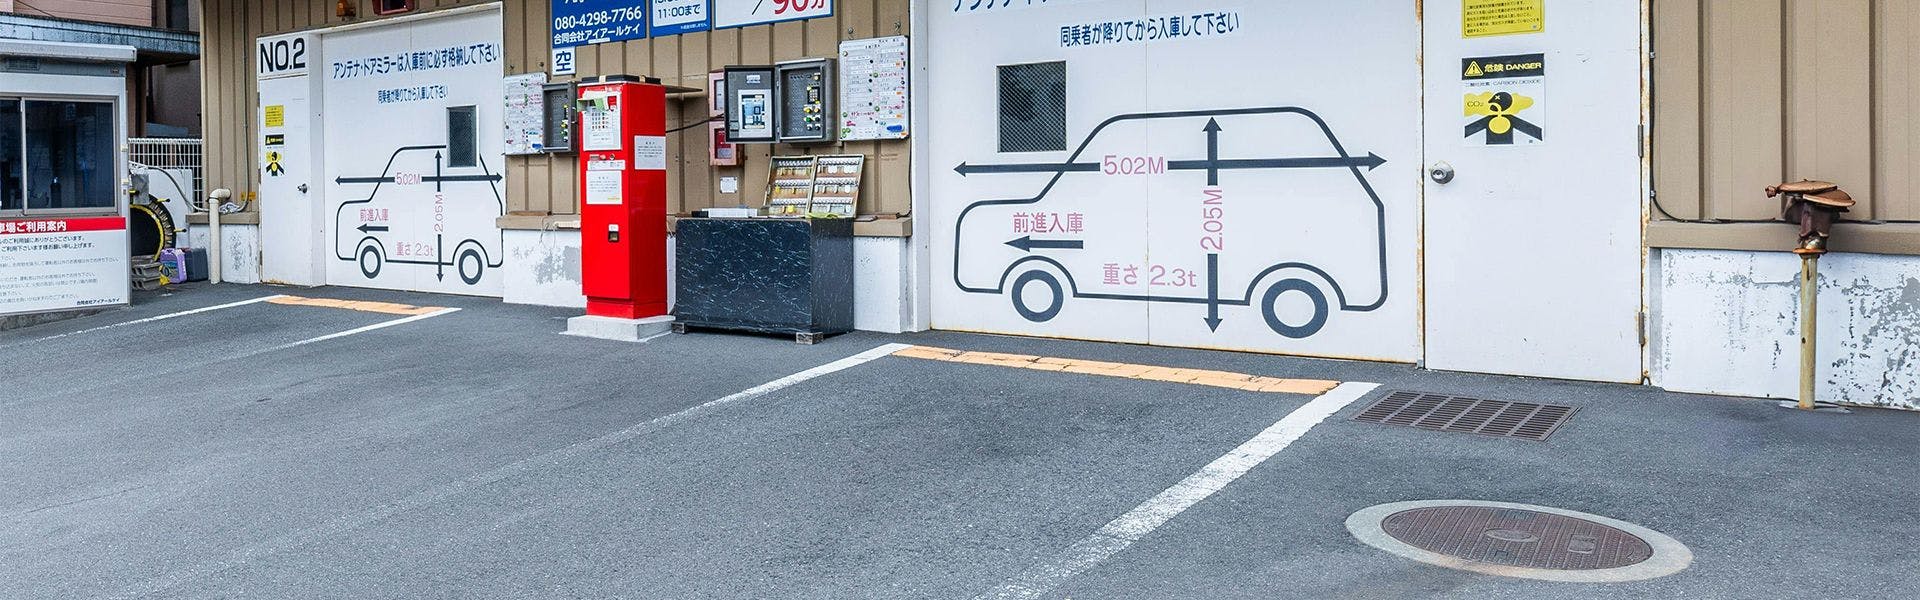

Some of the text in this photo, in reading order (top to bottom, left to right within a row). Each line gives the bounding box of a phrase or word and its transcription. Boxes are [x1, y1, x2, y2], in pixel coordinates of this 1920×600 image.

[555, 6, 642, 30] 080-4298-7766
[658, 4, 701, 19] 11:00まで
[554, 24, 641, 45] 合同会社アイアールケイ
[1060, 12, 1238, 47] 同乗者が降りてから入庫して下さい
[261, 38, 306, 73] NO.2
[556, 51, 572, 72] 空
[1505, 62, 1542, 71] DANGER
[1104, 155, 1164, 175] 5.02M
[360, 208, 389, 222] 前進入庫
[434, 194, 444, 232] 2.05M
[1013, 212, 1084, 235] 前進入庫
[1200, 189, 1222, 251] 2.05M
[396, 242, 434, 257] 重さ 2.3t
[1103, 263, 1197, 287] 重さ 2.3t
